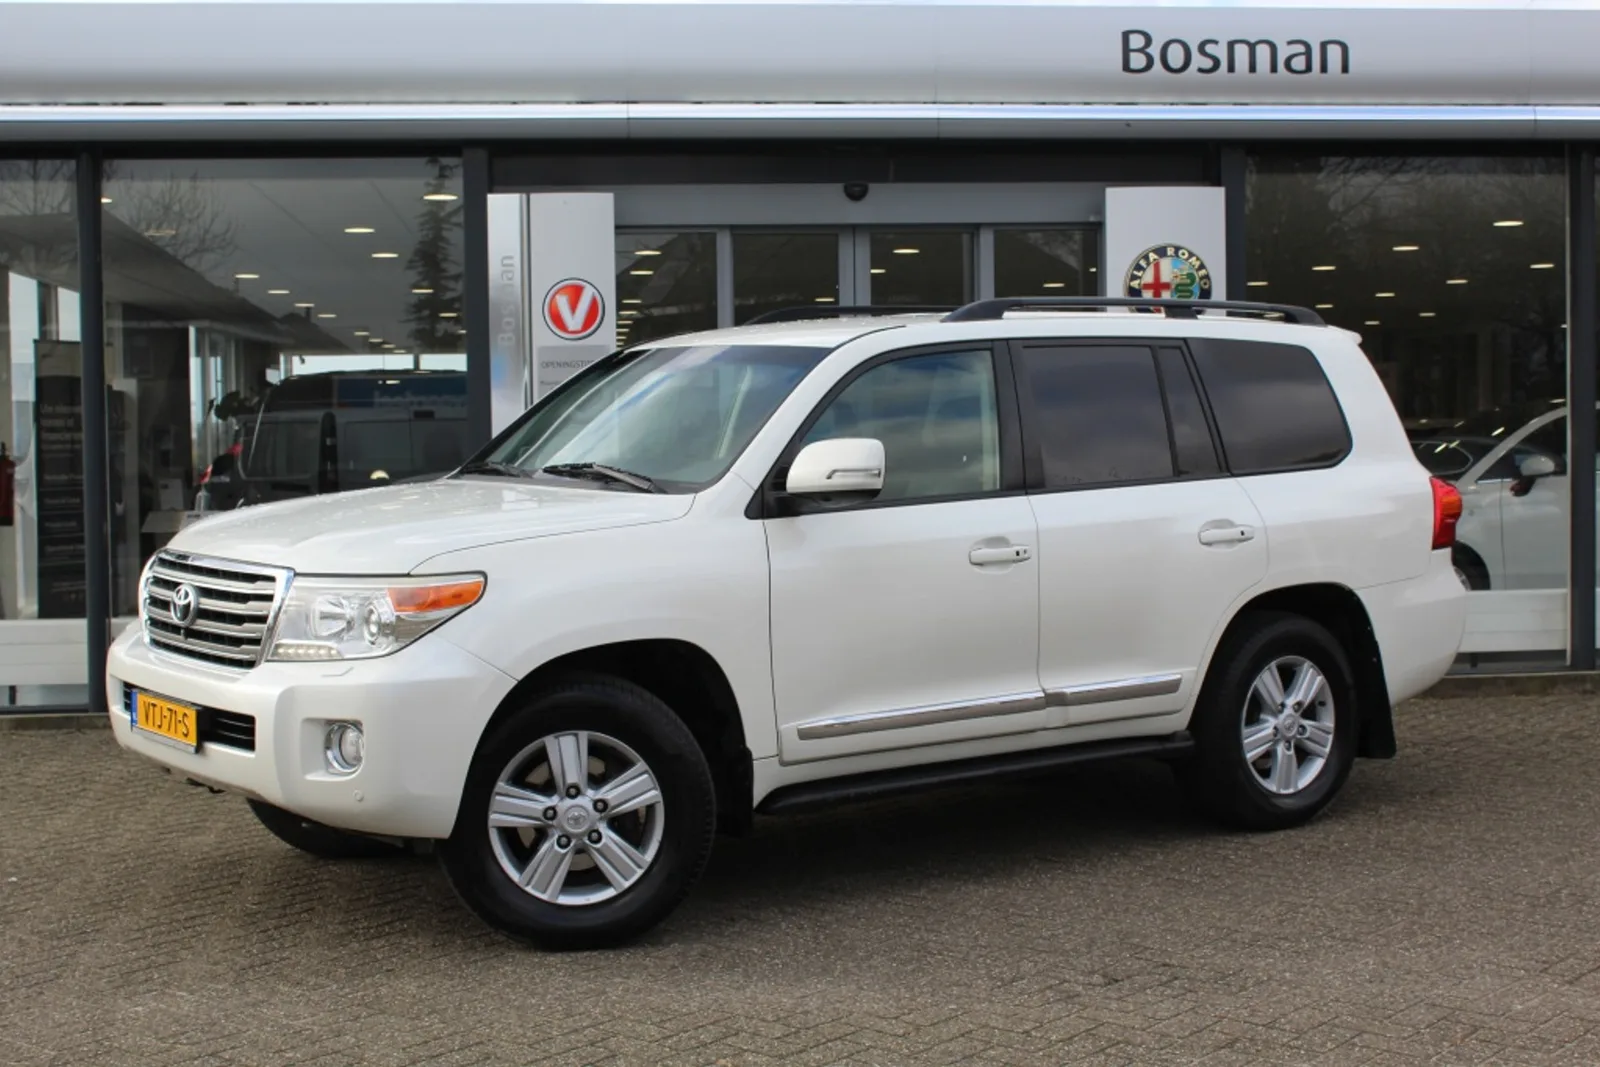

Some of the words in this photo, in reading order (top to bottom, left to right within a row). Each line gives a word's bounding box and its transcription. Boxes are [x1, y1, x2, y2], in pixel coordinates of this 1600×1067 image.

[1121, 29, 1350, 74] Bosman
[1129, 251, 1160, 289] ALFA
[1166, 246, 1211, 290] ROMEO
[554, 284, 596, 332] V
[143, 700, 190, 738] VTJ-71-S
